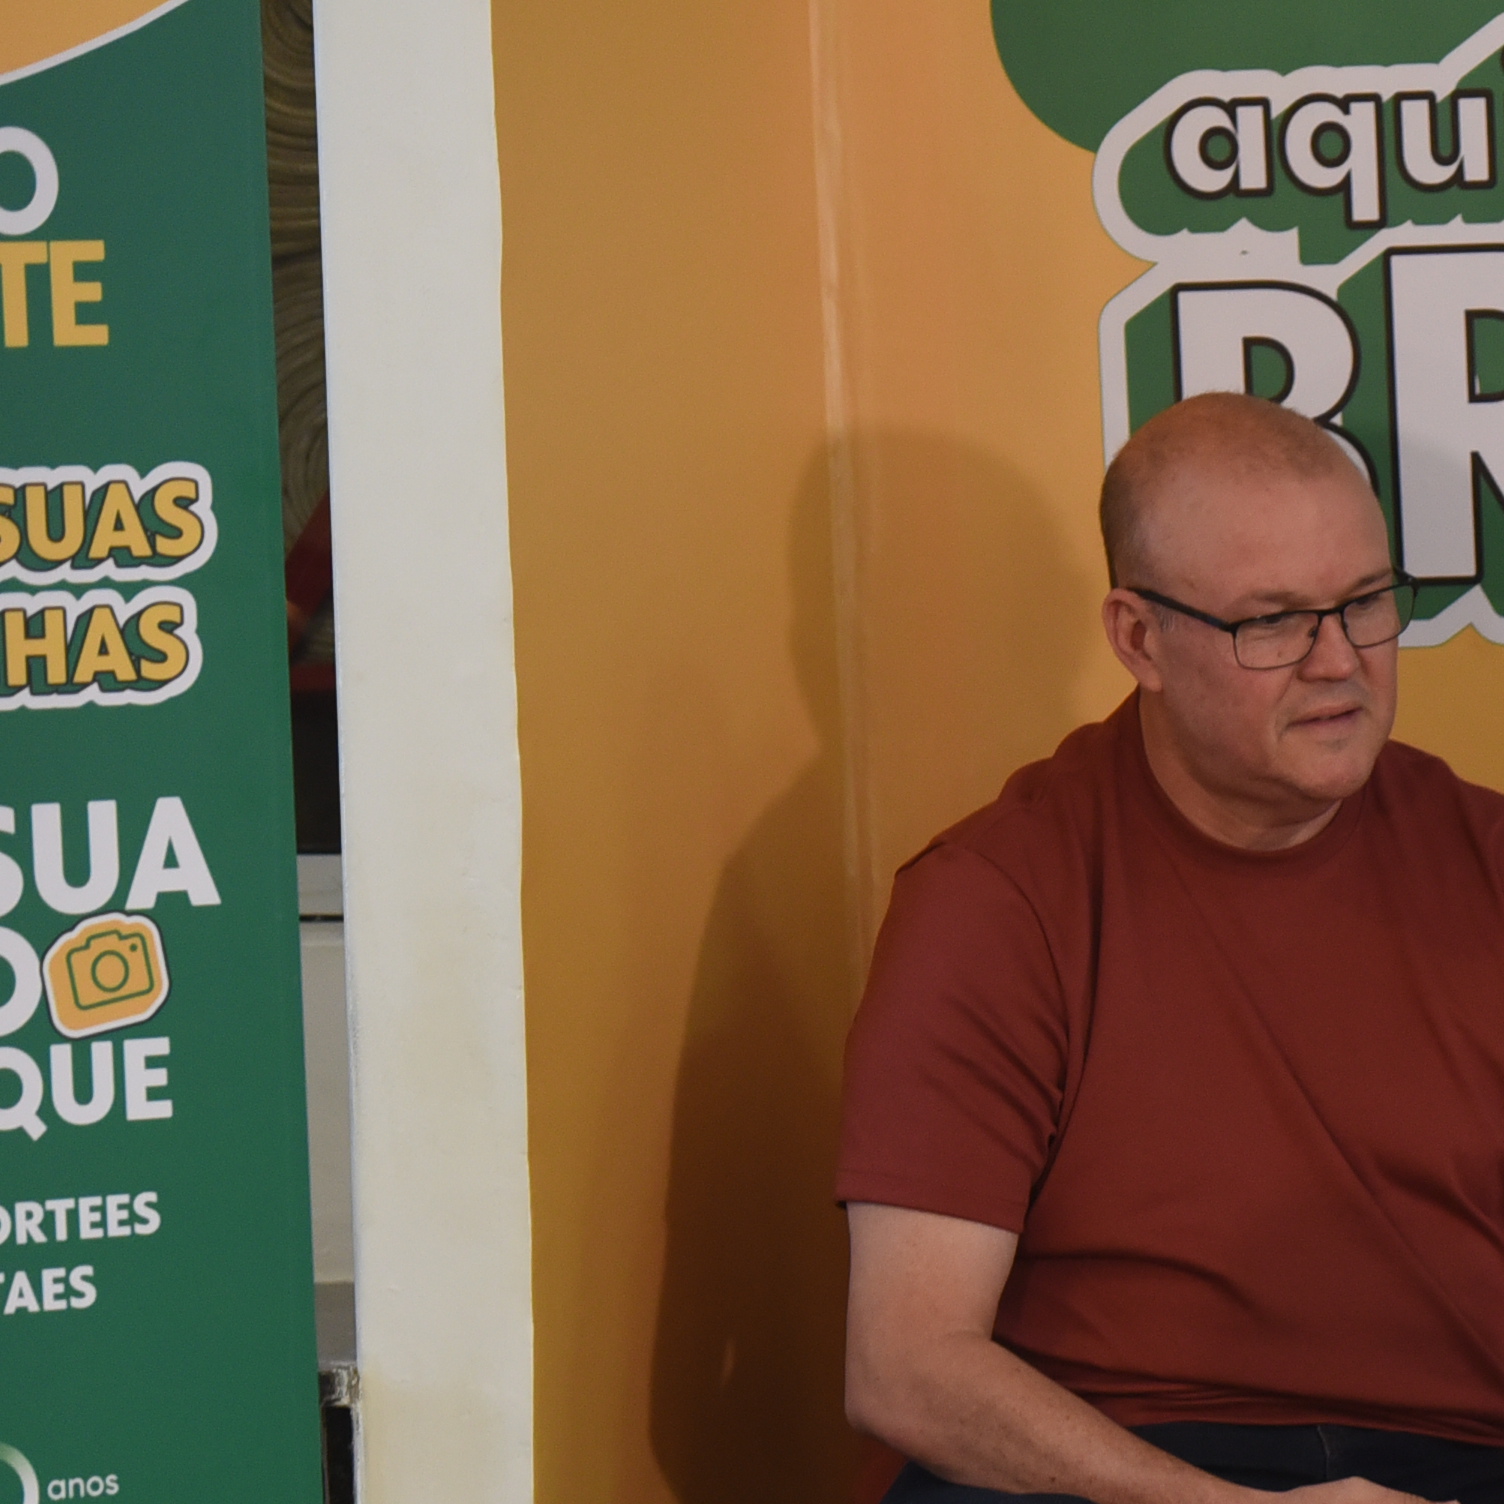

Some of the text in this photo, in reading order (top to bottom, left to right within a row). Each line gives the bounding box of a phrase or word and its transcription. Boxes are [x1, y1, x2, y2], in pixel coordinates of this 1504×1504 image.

[0, 239, 110, 348] TE
[3, 600, 190, 688] HAS
[0, 1036, 173, 1141] QUE
[0, 1190, 162, 1246] RTEES
[0, 1264, 97, 1315] AES
[46, 1473, 120, 1500] anos
